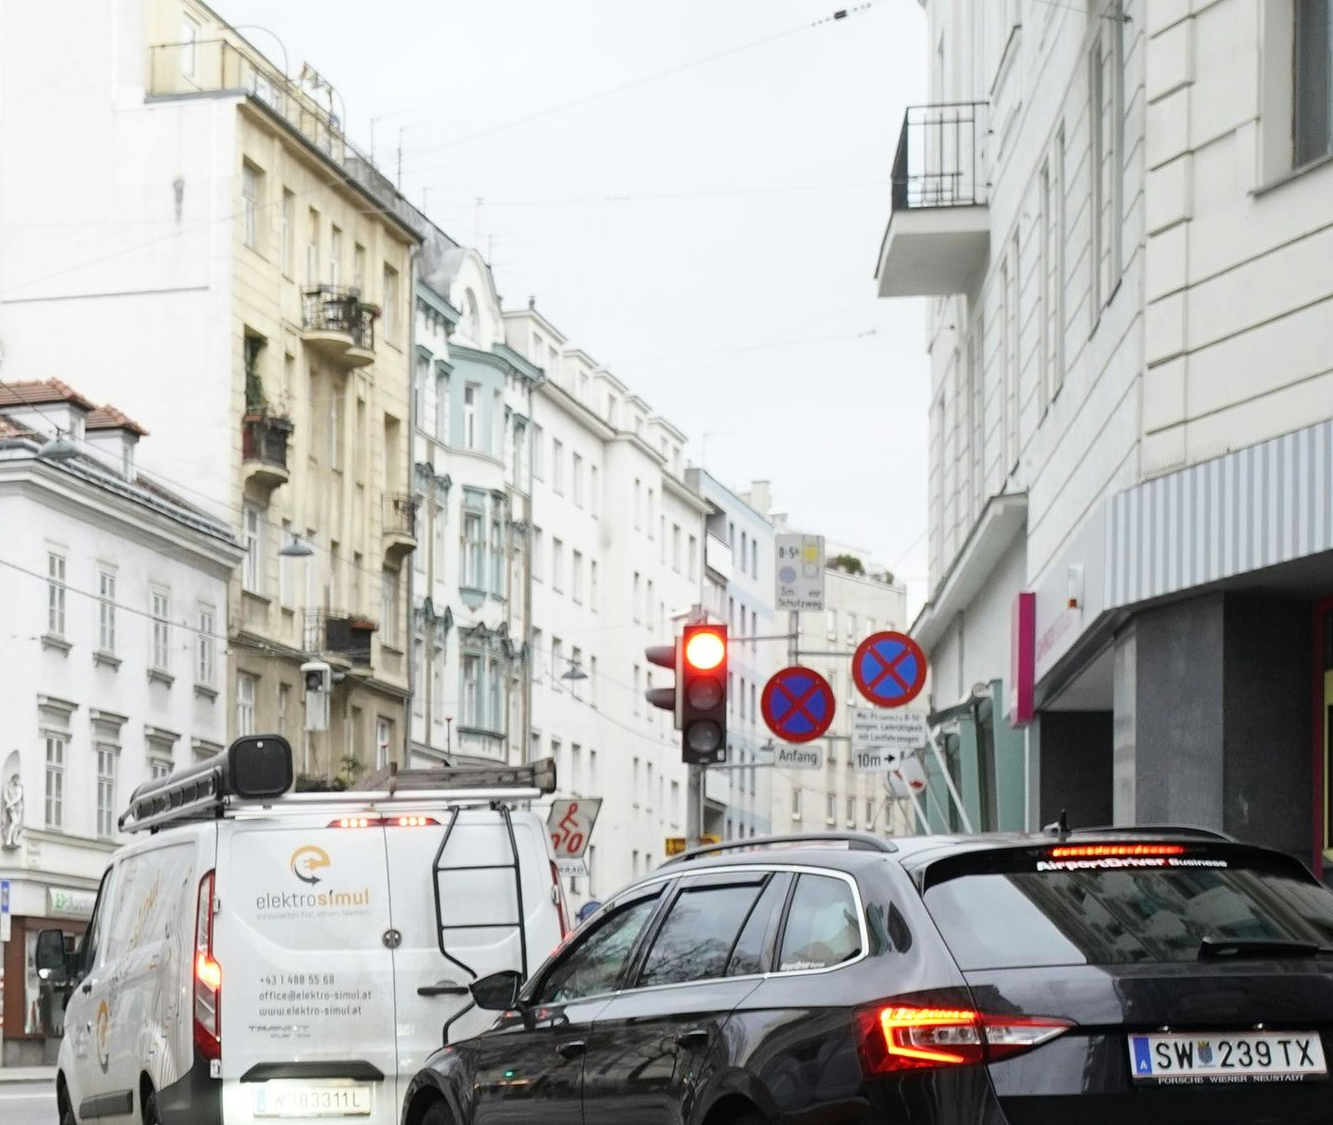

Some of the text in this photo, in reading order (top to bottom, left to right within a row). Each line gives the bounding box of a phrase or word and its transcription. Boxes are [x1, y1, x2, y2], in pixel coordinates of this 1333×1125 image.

[779, 749, 818, 766] Anfang
[857, 753, 881, 768] 10m
[1037, 857, 1227, 871] AirportDriver Business
[256, 888, 370, 910] elektrosimul
[259, 989, 372, 1001] office@elektro-simul.at
[259, 1006, 362, 1016] www.elektro-simul.at
[1155, 1039, 1314, 1069] SW 239 TX
[1158, 1073, 1304, 1085] PORSCHE WIENER NEUSTADT
